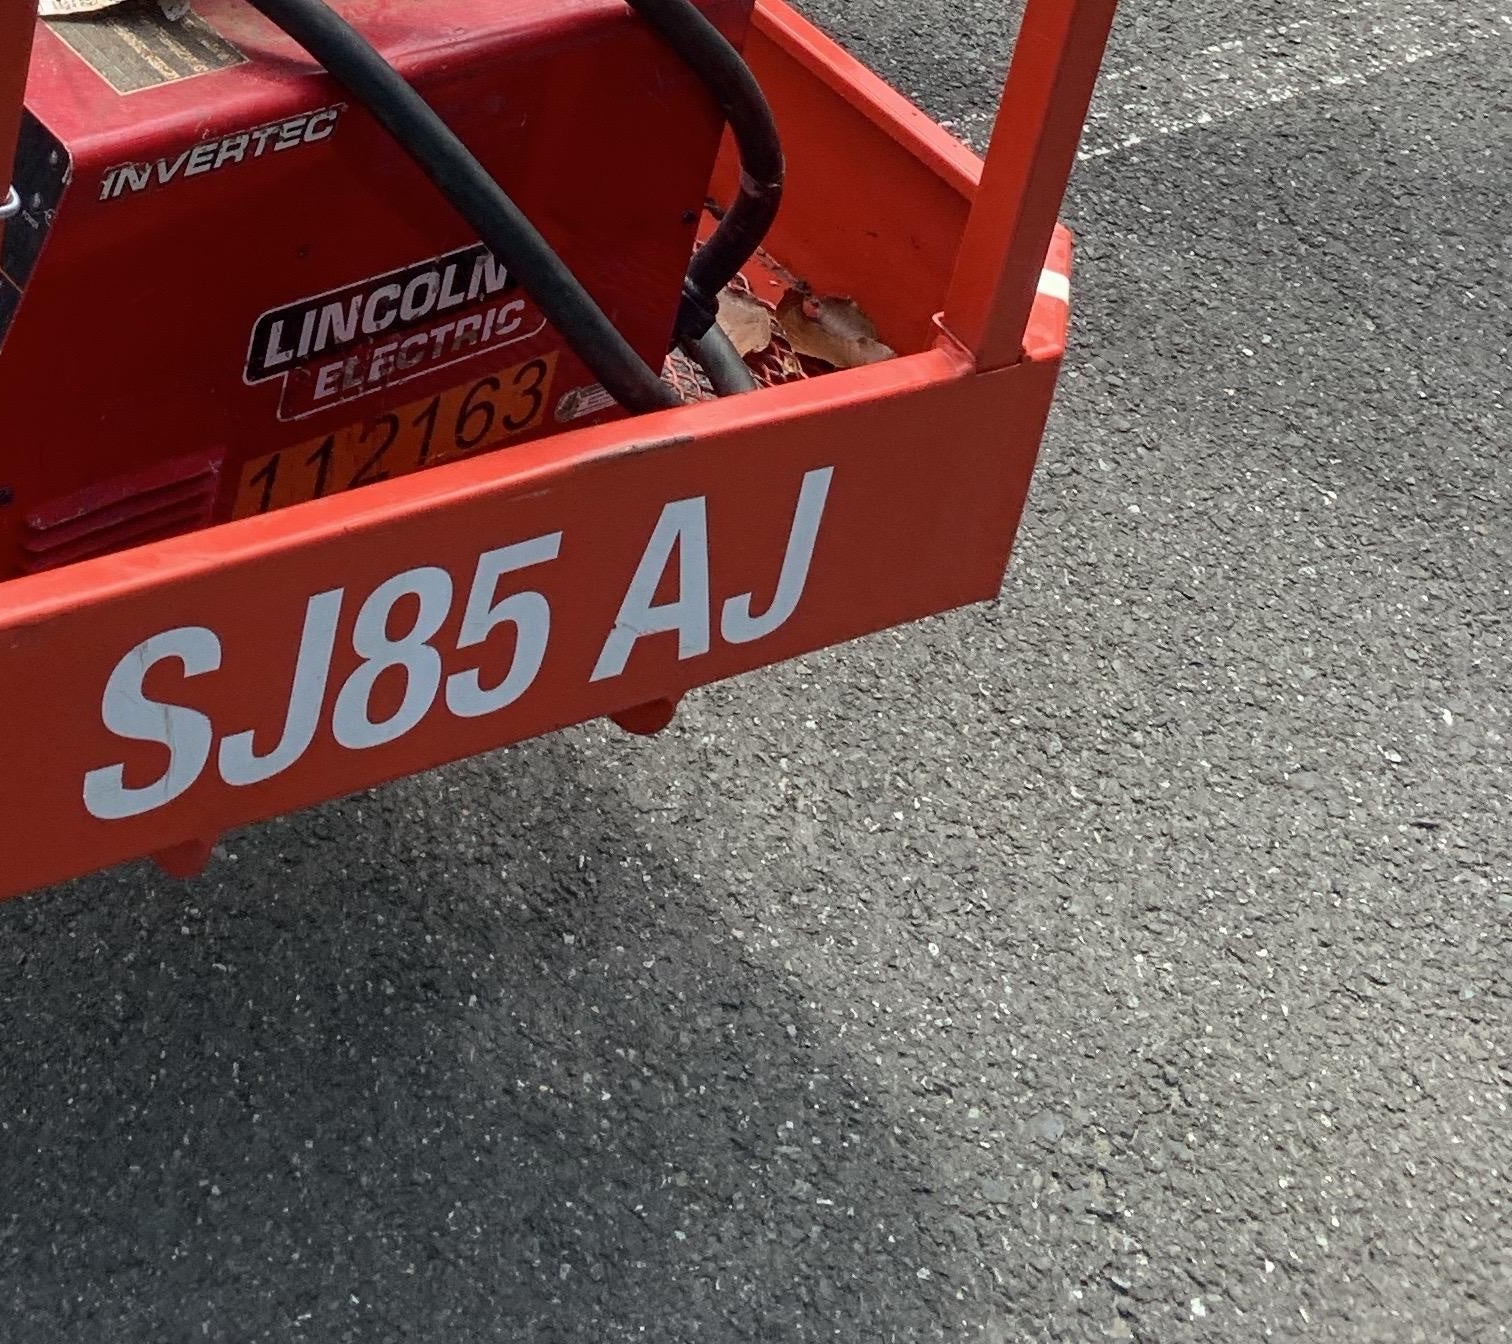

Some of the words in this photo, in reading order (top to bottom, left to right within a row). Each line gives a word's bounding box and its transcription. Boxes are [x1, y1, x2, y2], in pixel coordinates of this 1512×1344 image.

[99, 112, 338, 201] INVERTEC
[263, 255, 508, 368] LINCOLN
[313, 299, 525, 400] ELECTRIC
[249, 359, 549, 513] 112163
[82, 530, 563, 820] SJ85
[589, 466, 834, 683] AJ
